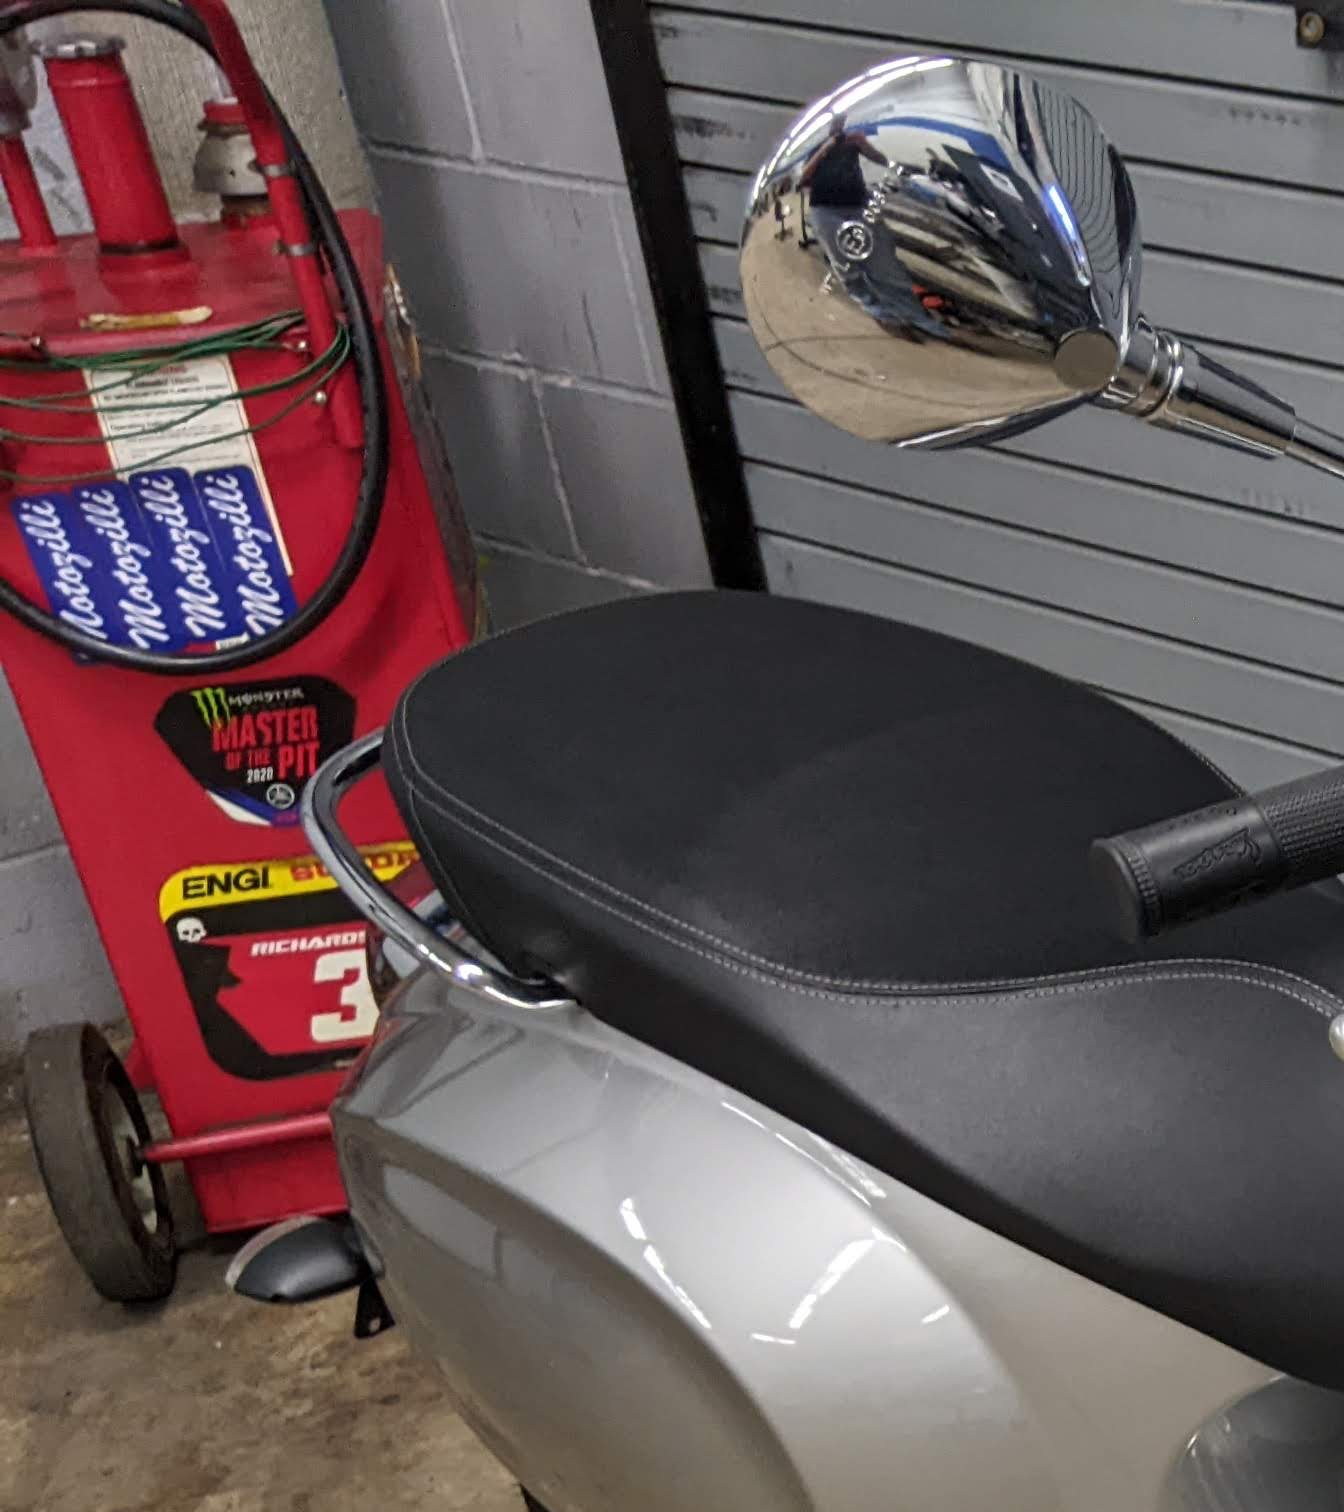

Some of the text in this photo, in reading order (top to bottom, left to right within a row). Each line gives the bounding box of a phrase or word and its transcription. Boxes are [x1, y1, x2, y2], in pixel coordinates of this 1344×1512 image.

[79, 488, 170, 649] Motozilli
[139, 474, 226, 638] Motozilli
[203, 473, 284, 635] Motozilli
[212, 705, 318, 752] MASTER
[247, 766, 274, 784] 2020
[278, 740, 320, 780] PIT
[182, 865, 271, 901] ENGI
